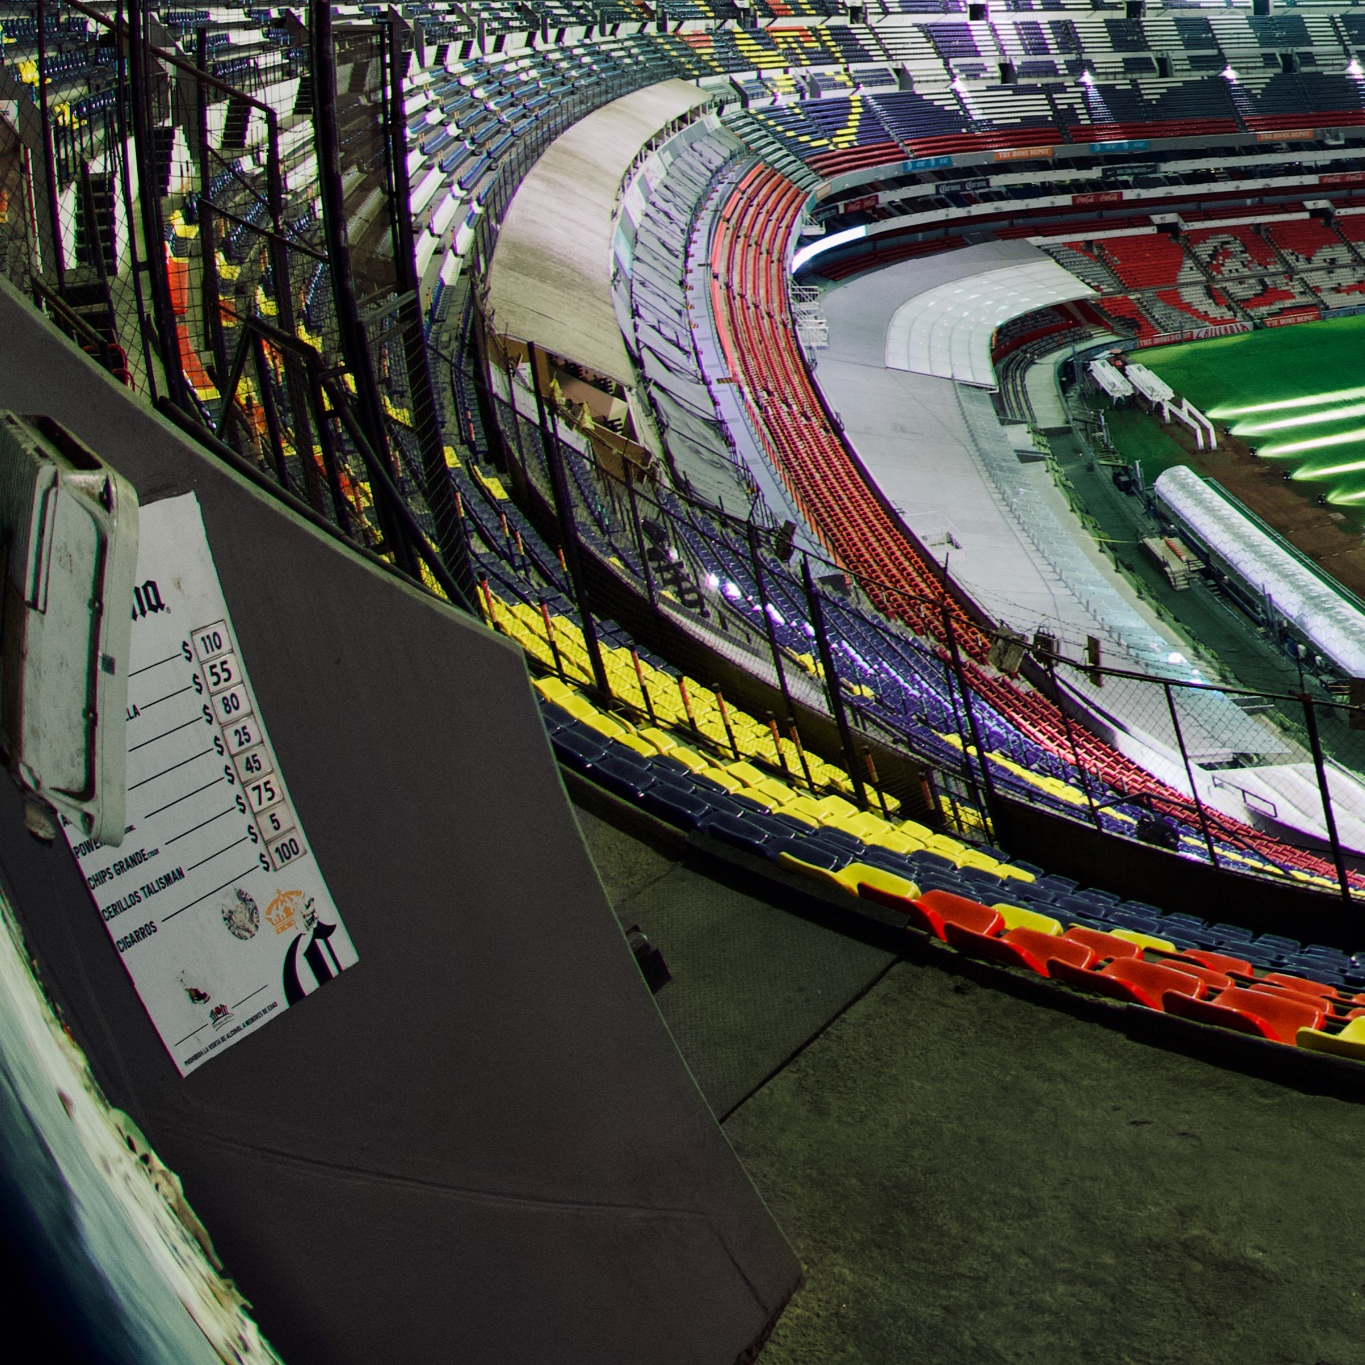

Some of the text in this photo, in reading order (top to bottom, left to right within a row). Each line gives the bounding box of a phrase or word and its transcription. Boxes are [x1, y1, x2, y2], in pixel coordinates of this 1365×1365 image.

[182, 631, 222, 662] $ 110
[192, 660, 232, 695] $ 55
[202, 692, 240, 725] $ 80
[213, 725, 251, 756] $ 25
[224, 764, 235, 785] $
[245, 753, 262, 773] 45
[87, 866, 114, 890] CHIPS
[113, 848, 149, 876] GRANDE
[235, 794, 246, 814] $
[251, 780, 276, 806] 75
[101, 813, 281, 922] CERILLOS TALISMAN $ 5
[116, 838, 300, 953] CIGARROS $ 100
